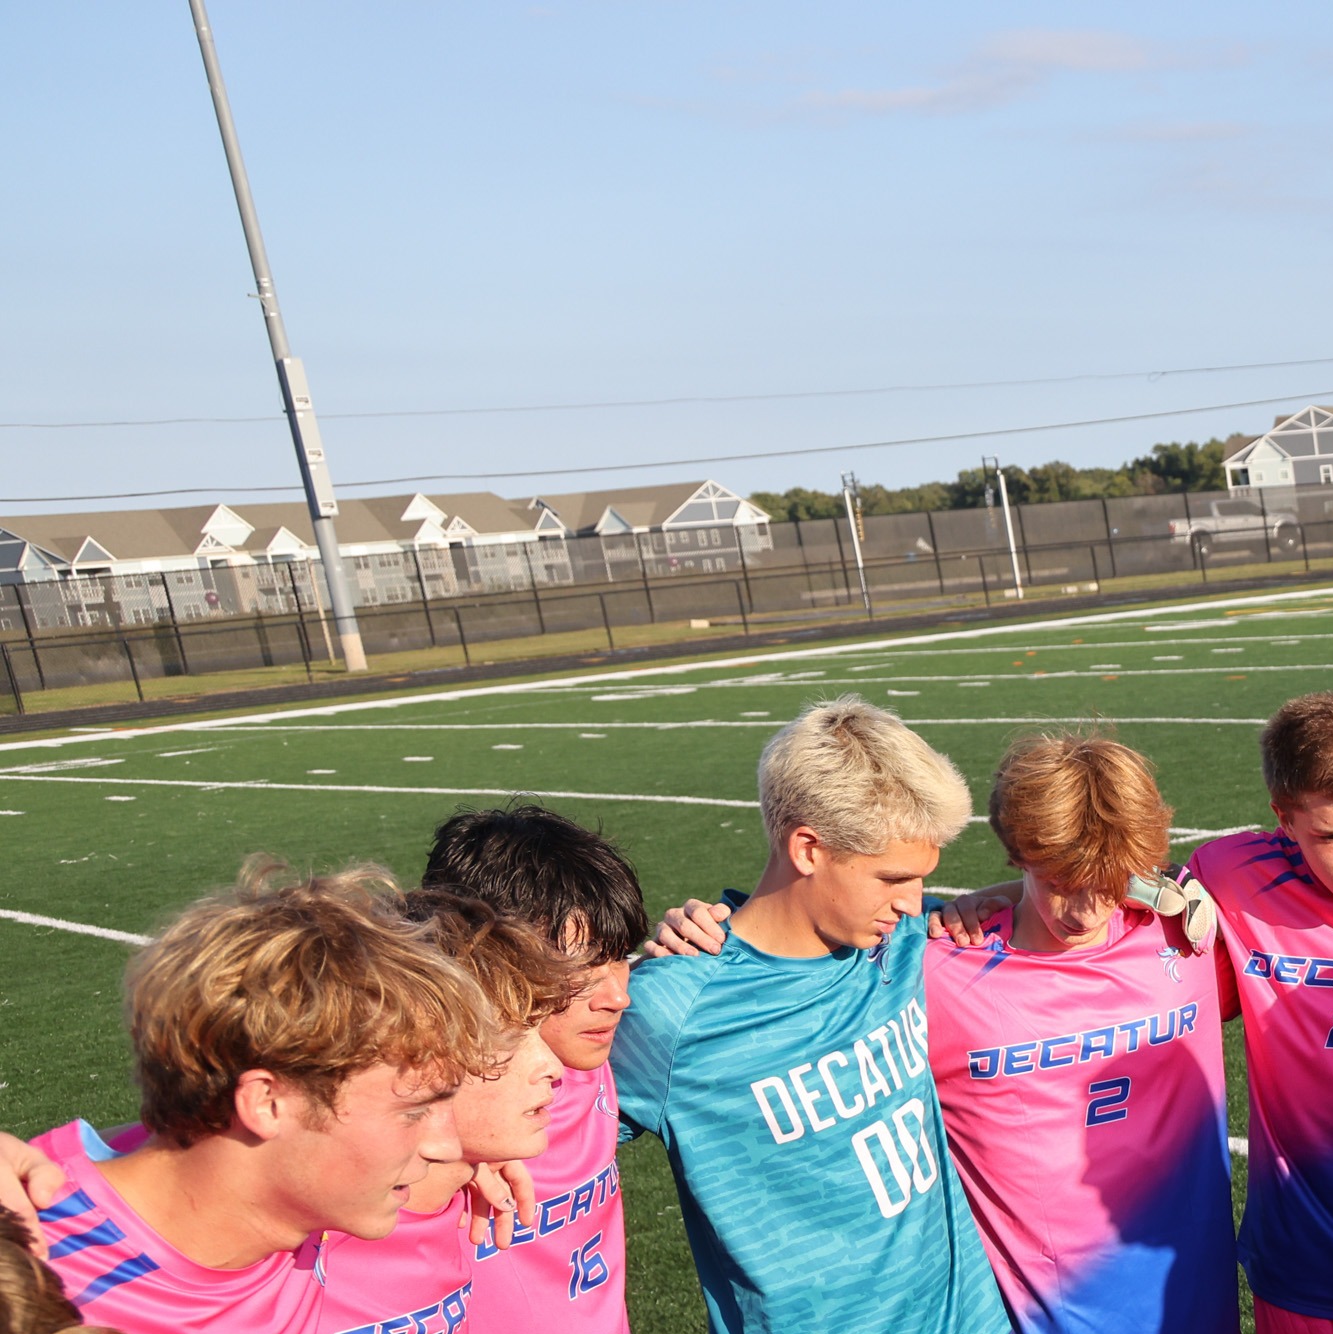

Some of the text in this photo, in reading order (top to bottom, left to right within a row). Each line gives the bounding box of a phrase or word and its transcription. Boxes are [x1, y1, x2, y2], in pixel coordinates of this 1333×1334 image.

[750, 997, 929, 1146] DECATUR
[968, 1002, 1199, 1081] DECATUR
[1085, 1076, 1132, 1129] 2
[851, 1097, 939, 1220] 00
[474, 1157, 619, 1262] DECATU
[568, 1229, 610, 1302] 16
